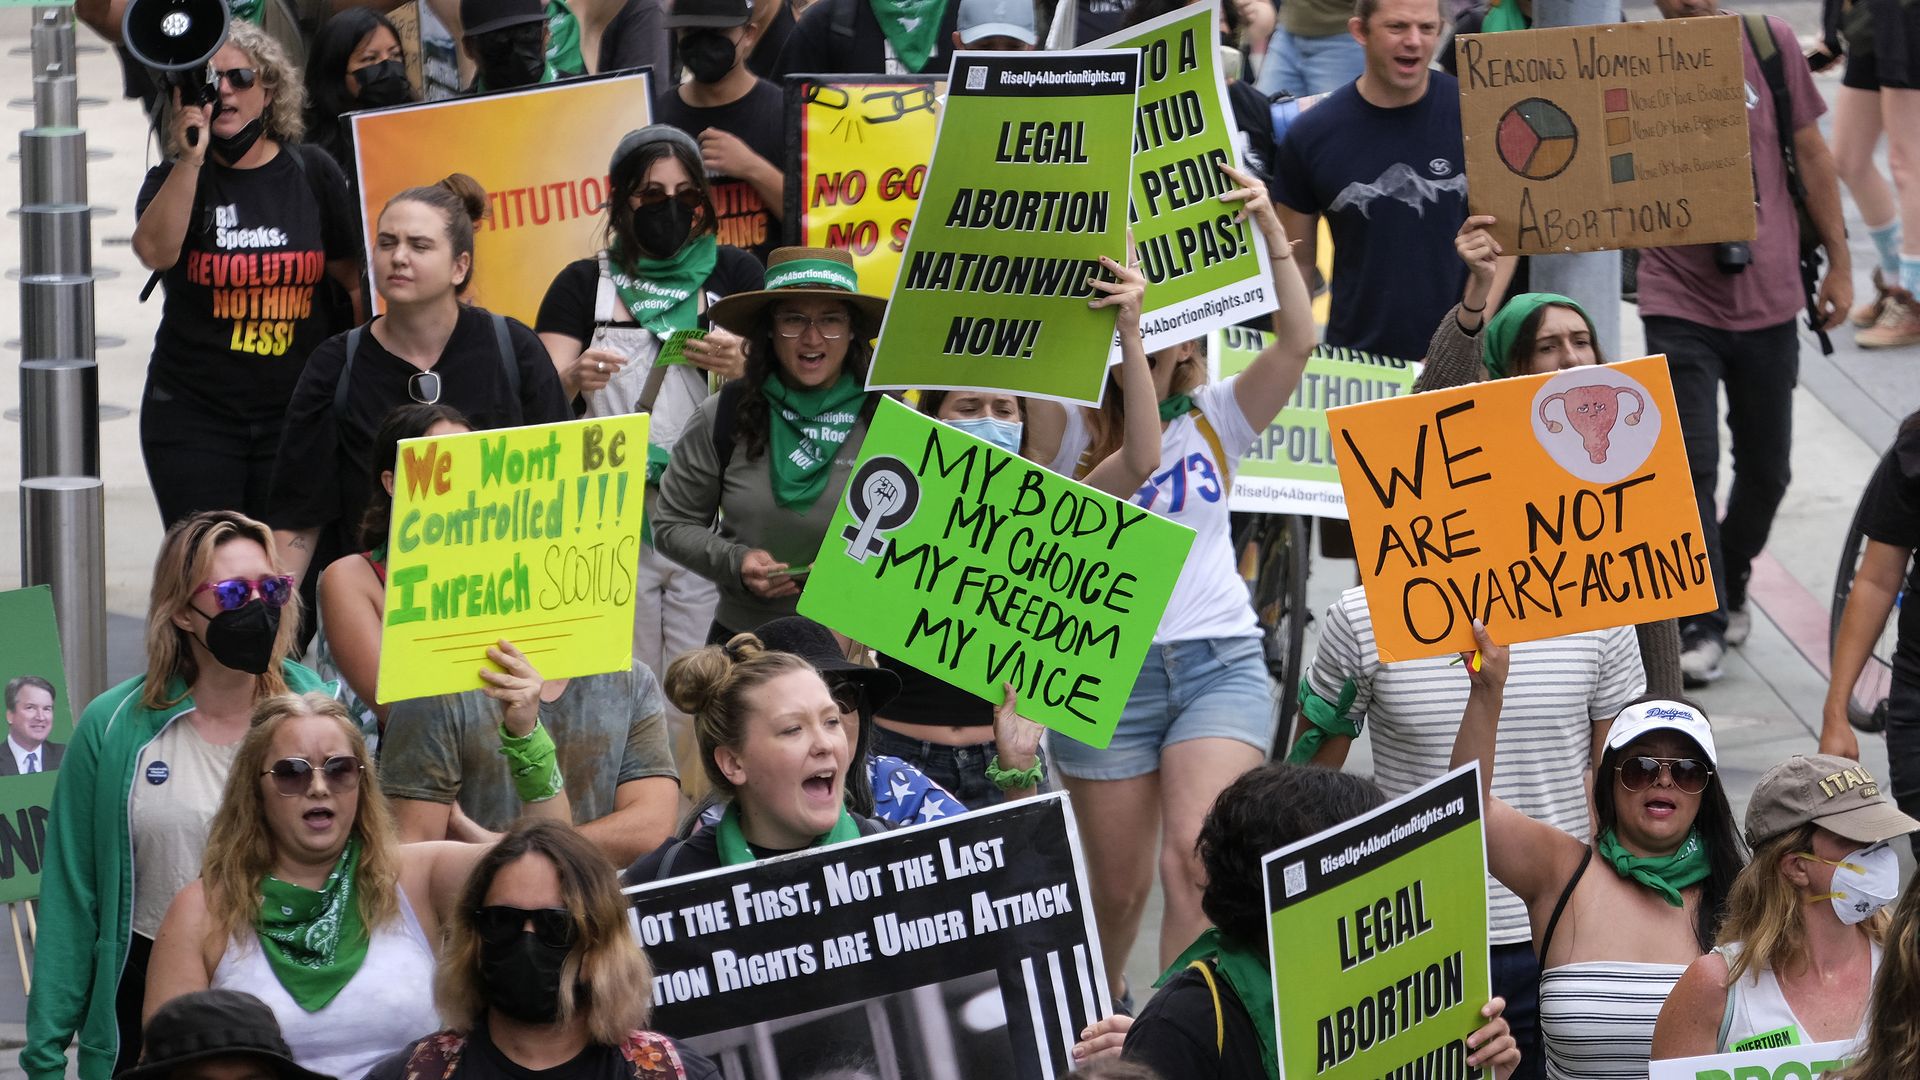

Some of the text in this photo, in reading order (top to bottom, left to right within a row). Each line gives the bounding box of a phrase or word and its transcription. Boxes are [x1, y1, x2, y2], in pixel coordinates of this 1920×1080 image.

[999, 69, 1126, 88] RiseUp4AbortionRights.org
[1138, 28, 1198, 88] TO A
[1461, 36, 1714, 90] REASONS WOMEN HAVE
[995, 120, 1089, 165] LEGAL
[1133, 89, 1206, 157] ITUD
[215, 203, 239, 228] BA
[473, 175, 612, 234] TITUTIO
[811, 164, 928, 209] NO GO
[944, 187, 1110, 235] ABORTION
[215, 225, 289, 250] Speaks:
[715, 212, 768, 248] HING
[824, 217, 913, 257] NO S
[1517, 186, 1693, 250] ABORTIONS
[186, 250, 326, 288] REVOLUTION
[212, 285, 315, 320] NOTHING
[230, 319, 296, 357] LESS!
[943, 315, 1044, 360] NOW!
[402, 423, 627, 503] We Wont Be
[1245, 423, 1337, 466] APOL
[1341, 399, 1492, 509] WE
[917, 426, 1148, 550] MY BODY
[1234, 483, 1345, 505] RiseUp4Abortion
[1374, 472, 1656, 577] ARE NOT
[538, 534, 635, 611] SCOTUS
[942, 495, 1138, 614] MY CHOICE
[874, 537, 1121, 660] MY FREEDOM
[1402, 532, 1707, 646] OVARY-ACTING
[904, 606, 1103, 726] MY VOICE
[1644, 707, 1694, 721] Dodgers
[1817, 766, 1877, 799] ITAL
[1319, 796, 1465, 877] RiseUp4AbortionRights.org
[679, 899, 731, 938] THE
[731, 881, 823, 928] FIRST,
[823, 861, 882, 907] NOT
[887, 852, 938, 892] THE
[938, 837, 1005, 882] LAST
[651, 882, 1073, 1007] TION RIGHTS ARE UNDER ATTACK
[1336, 879, 1434, 974] LEGAL
[1315, 950, 1465, 1076] ABORTION
